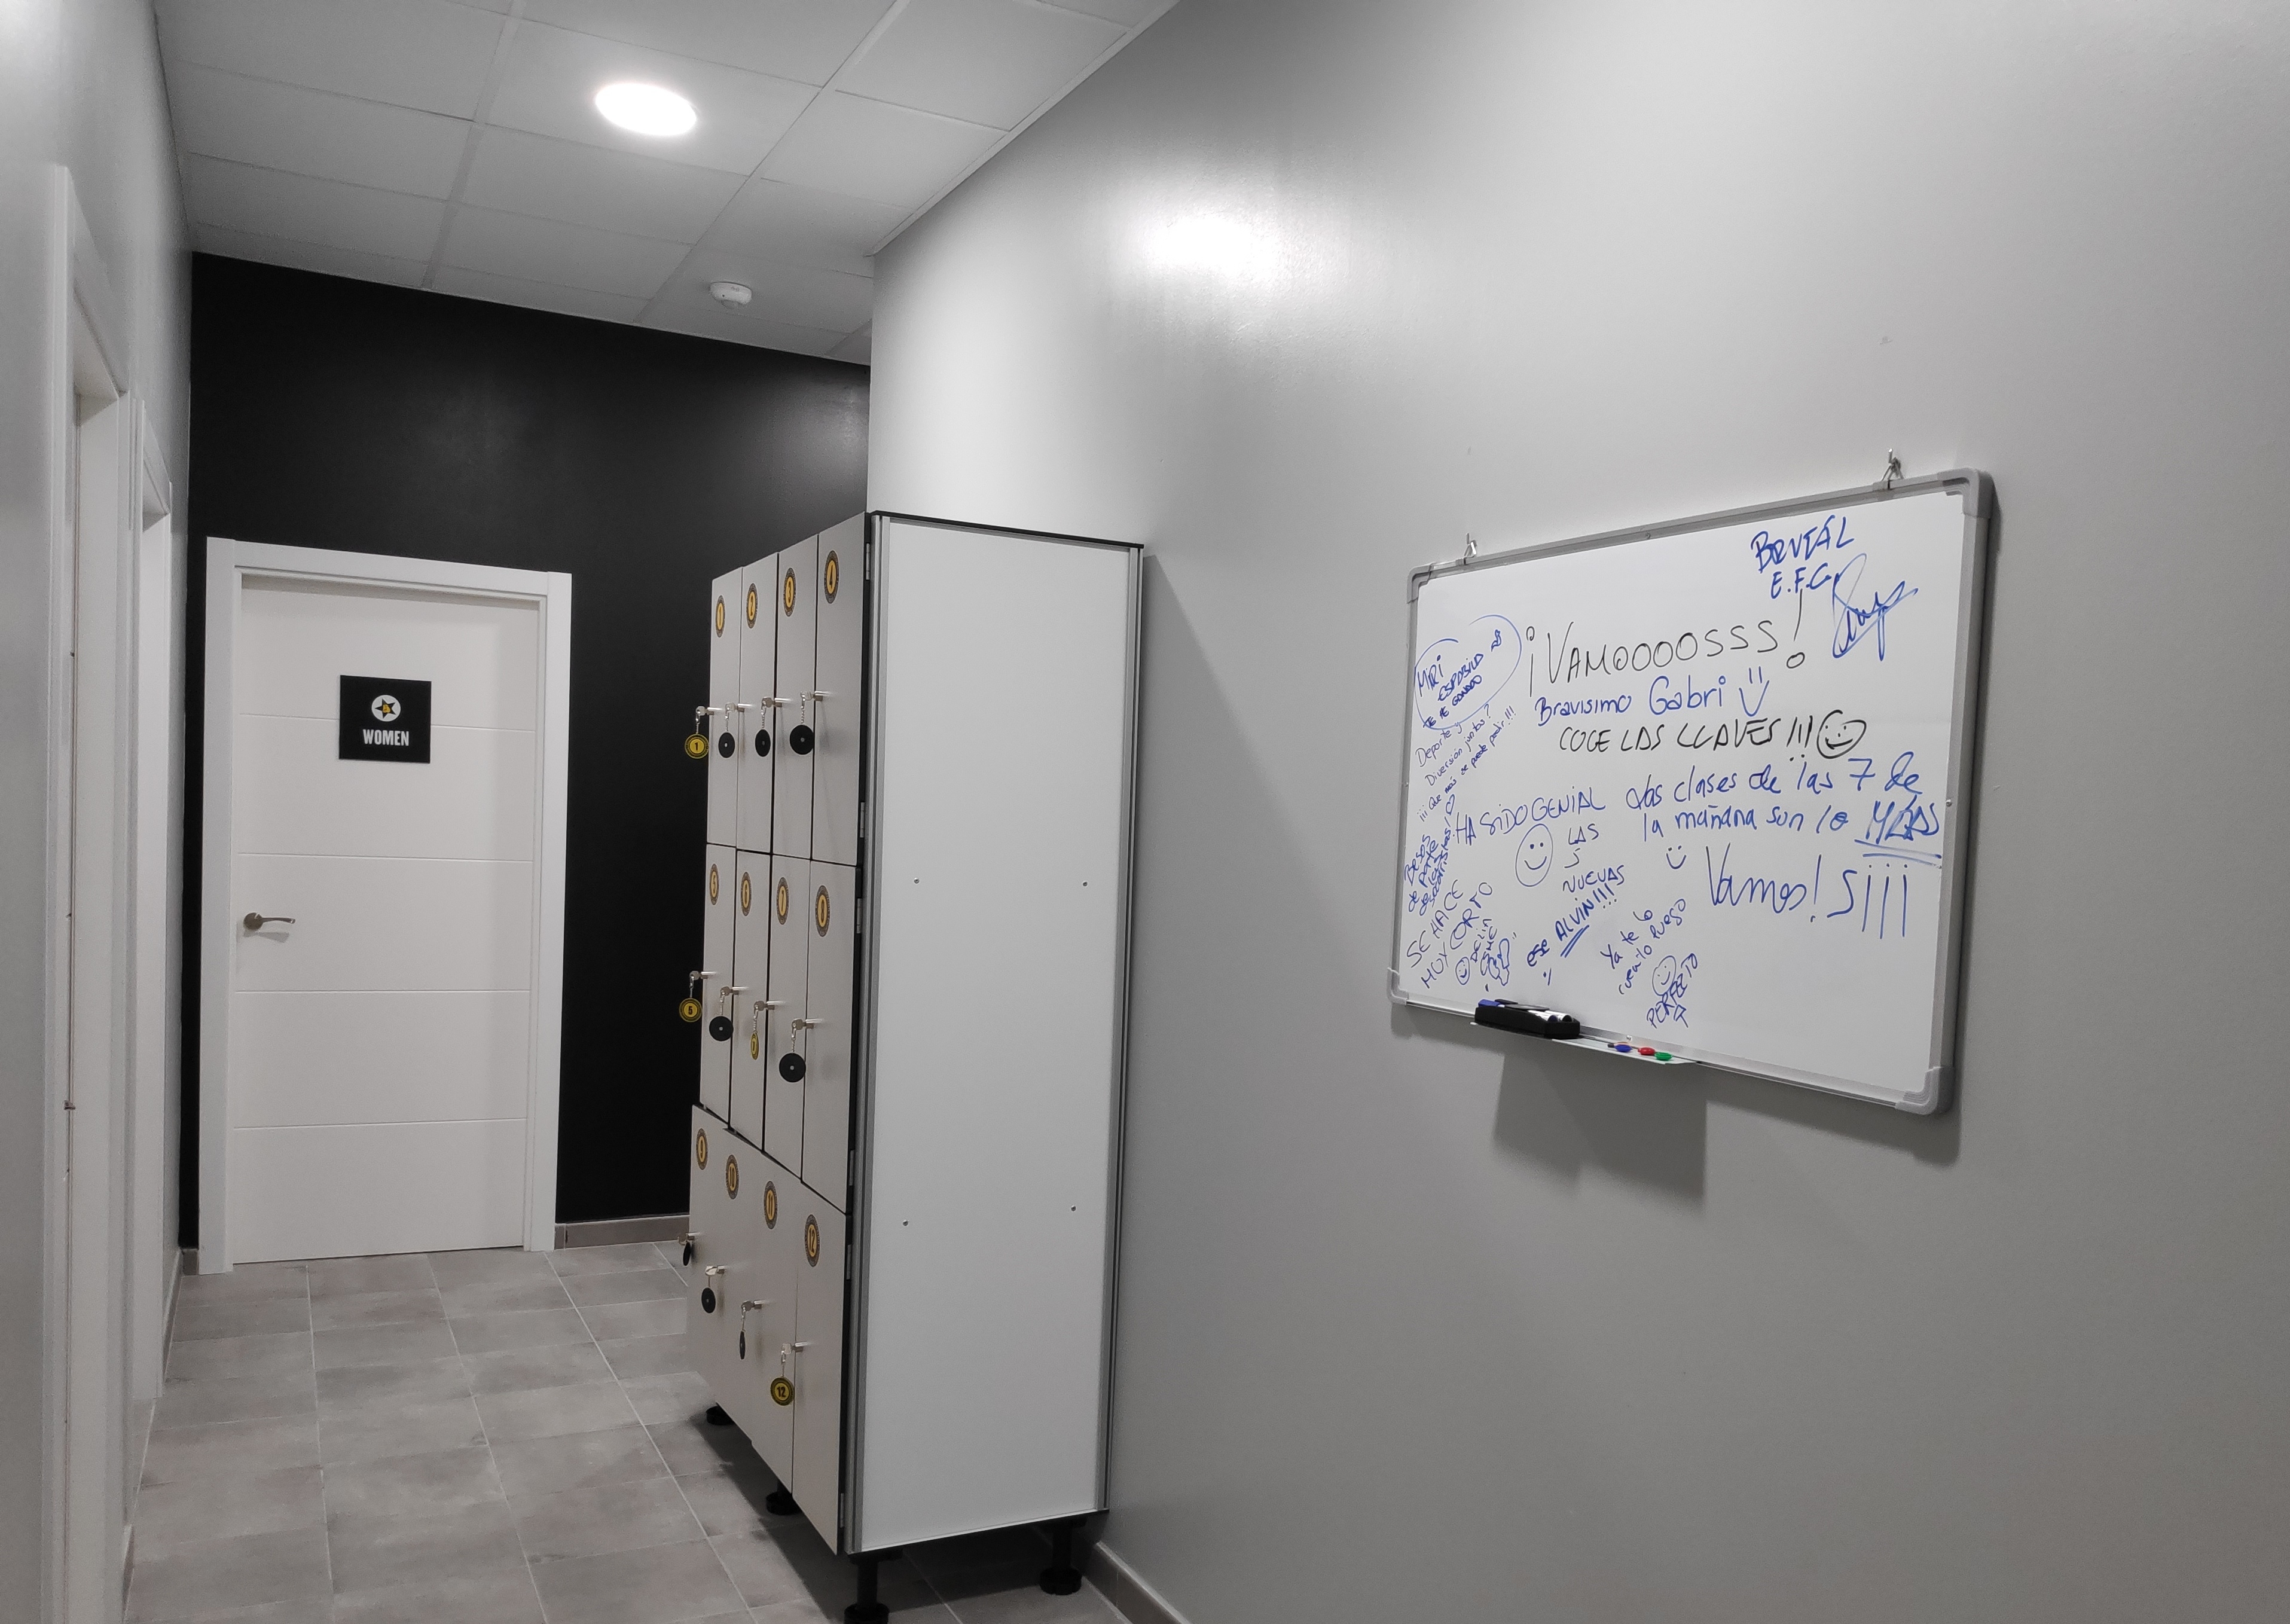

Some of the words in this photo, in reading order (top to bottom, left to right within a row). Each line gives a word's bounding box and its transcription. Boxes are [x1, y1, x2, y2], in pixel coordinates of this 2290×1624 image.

[829, 564, 833, 590] 4
[1649, 675, 1726, 715] Gabri
[362, 729, 410, 746] WOMEN
[694, 742, 698, 751] 1
[1415, 729, 1452, 767] Deporte
[1560, 726, 1611, 752] COGE
[1621, 726, 1665, 751] LAS
[1471, 744, 1488, 768] puede
[1674, 765, 1737, 802] clases
[1749, 764, 1781, 794] de
[1797, 761, 1833, 795] las
[1848, 758, 1876, 791] 7
[1884, 751, 1923, 795] de
[1456, 812, 1476, 845] HA
[1568, 823, 1599, 845] LAS
[1644, 813, 1664, 842] la
[1675, 805, 1757, 830] mañana
[1766, 806, 1804, 831] son
[1405, 834, 1431, 886] Besos
[1562, 865, 1625, 893] NUEVAS
[1407, 930, 1431, 968] SE
[1430, 879, 1463, 939] HACE
[1650, 898, 1686, 939] luego
[1599, 944, 1623, 969] Ya
[1620, 930, 1639, 945] te
[688, 1006, 693, 1015] 5
[729, 1166, 735, 1188] 10
[808, 1227, 816, 1254] 12
[777, 1386, 787, 1397] 12
